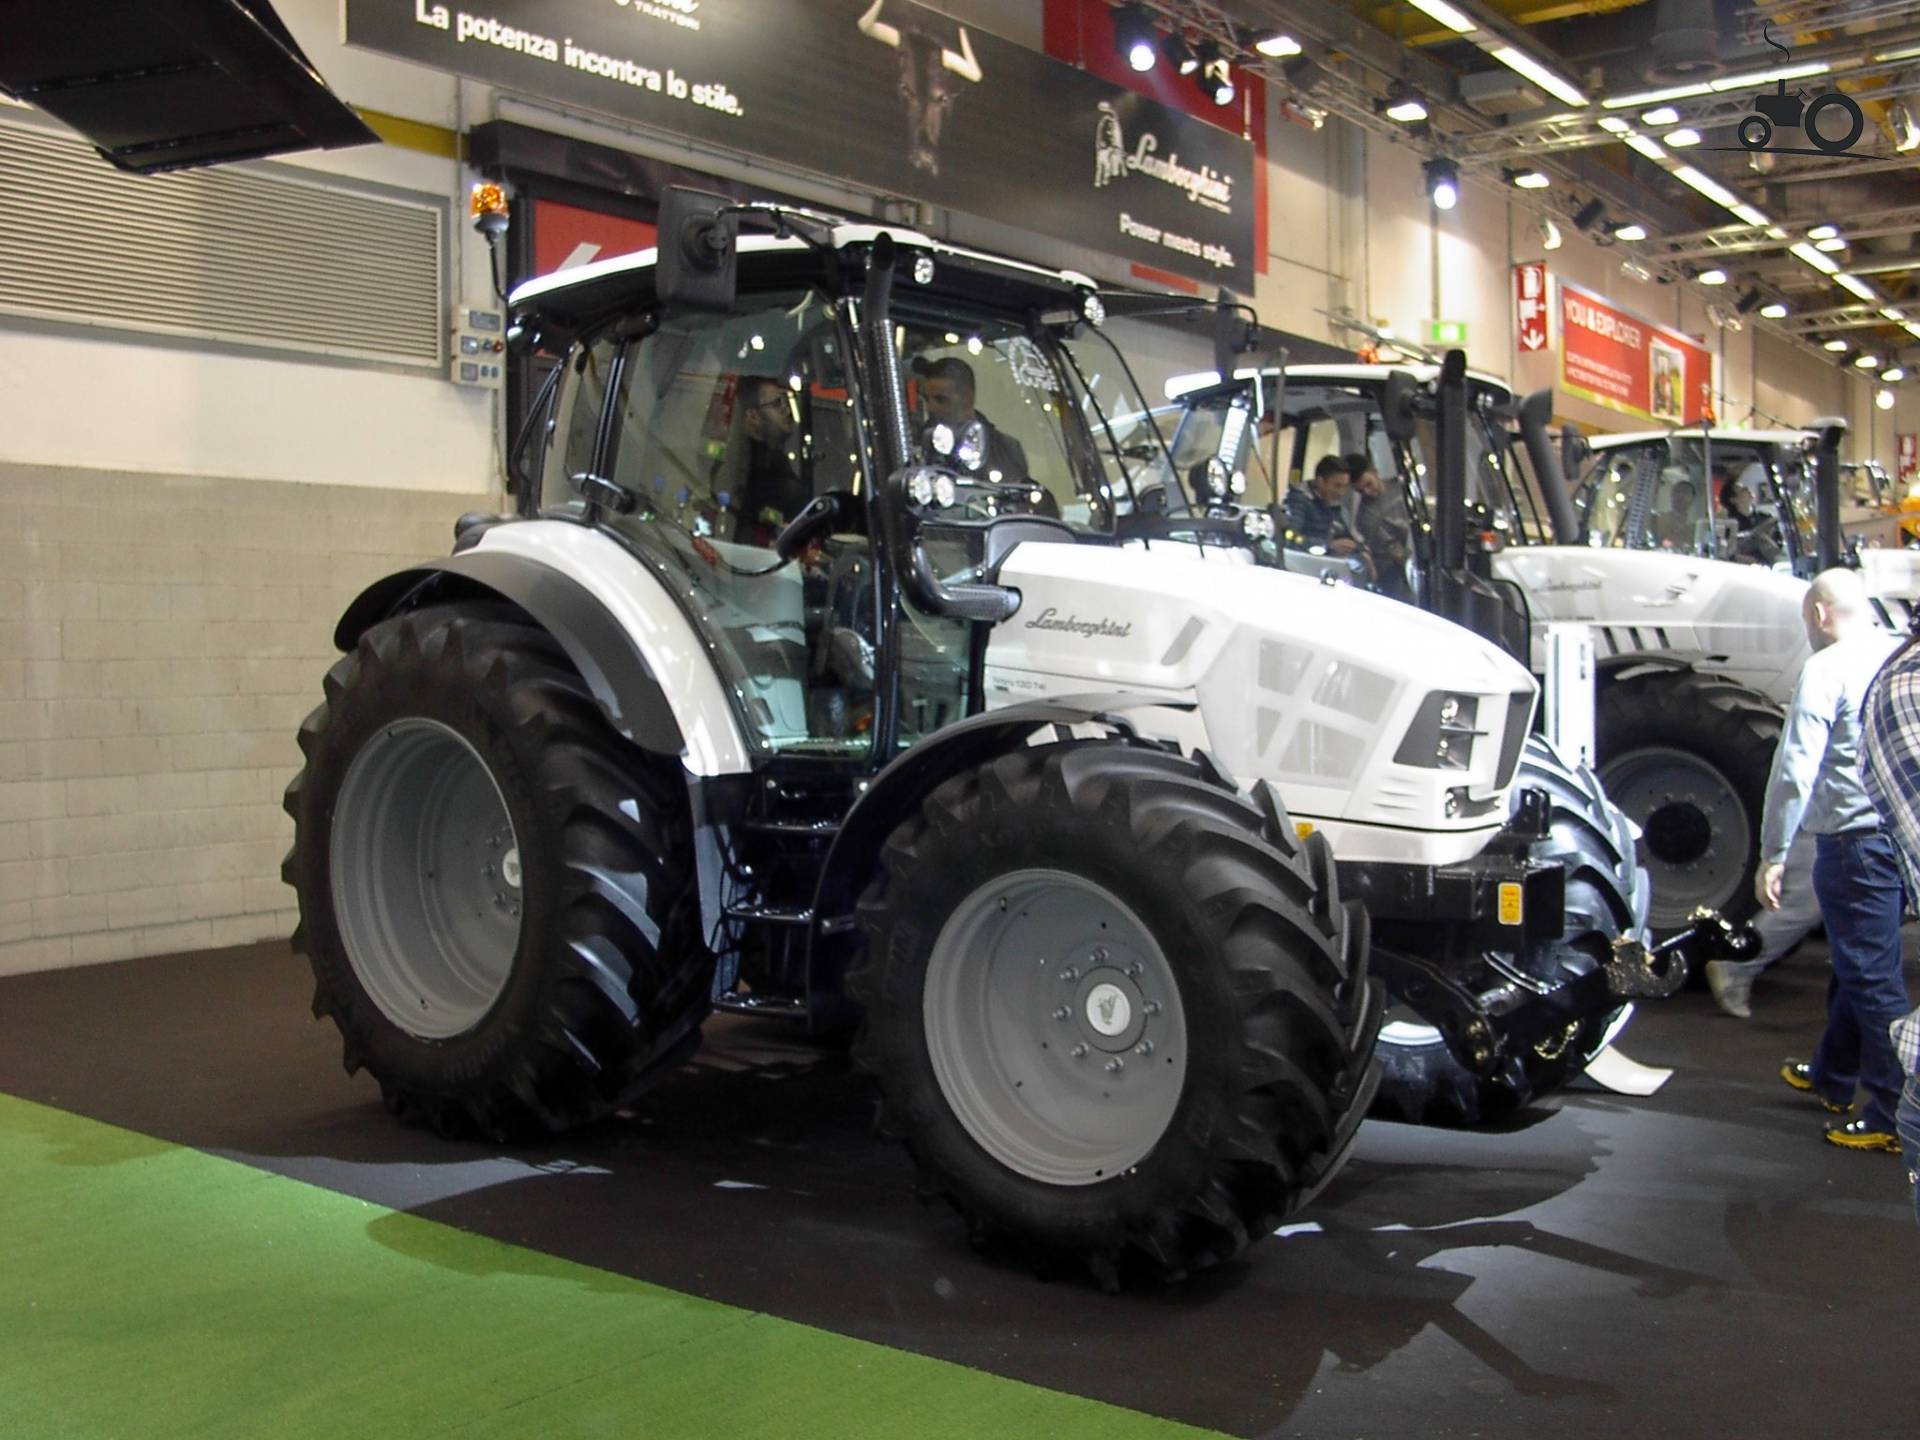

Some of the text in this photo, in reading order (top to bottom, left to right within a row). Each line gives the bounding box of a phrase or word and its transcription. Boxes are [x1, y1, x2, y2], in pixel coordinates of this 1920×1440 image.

[416, 0, 744, 117] La potenza incontra lo stile.
[1126, 133, 1234, 203] Lamborghini
[1120, 212, 1162, 243] Power
[1162, 232, 1201, 257] meets
[1025, 607, 1133, 639] Lamborghini
